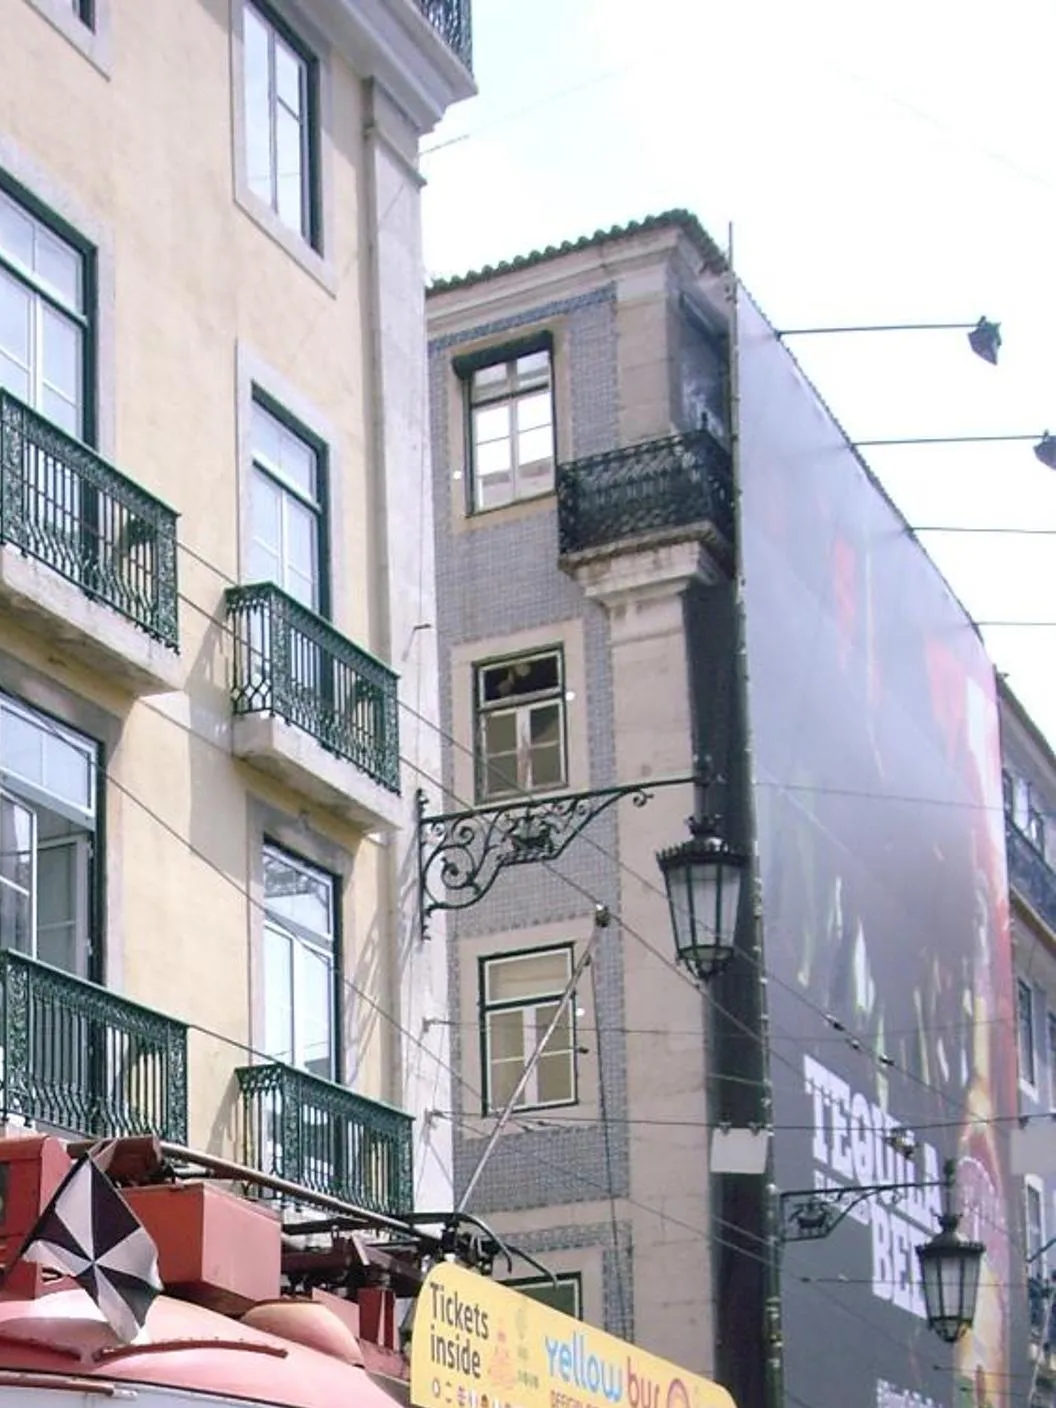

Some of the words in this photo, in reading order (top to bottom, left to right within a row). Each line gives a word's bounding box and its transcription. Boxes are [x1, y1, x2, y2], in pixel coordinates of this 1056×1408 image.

[430, 1281, 490, 1340] Tickets
[430, 1324, 481, 1379] inside
[545, 1331, 623, 1404] yellow
